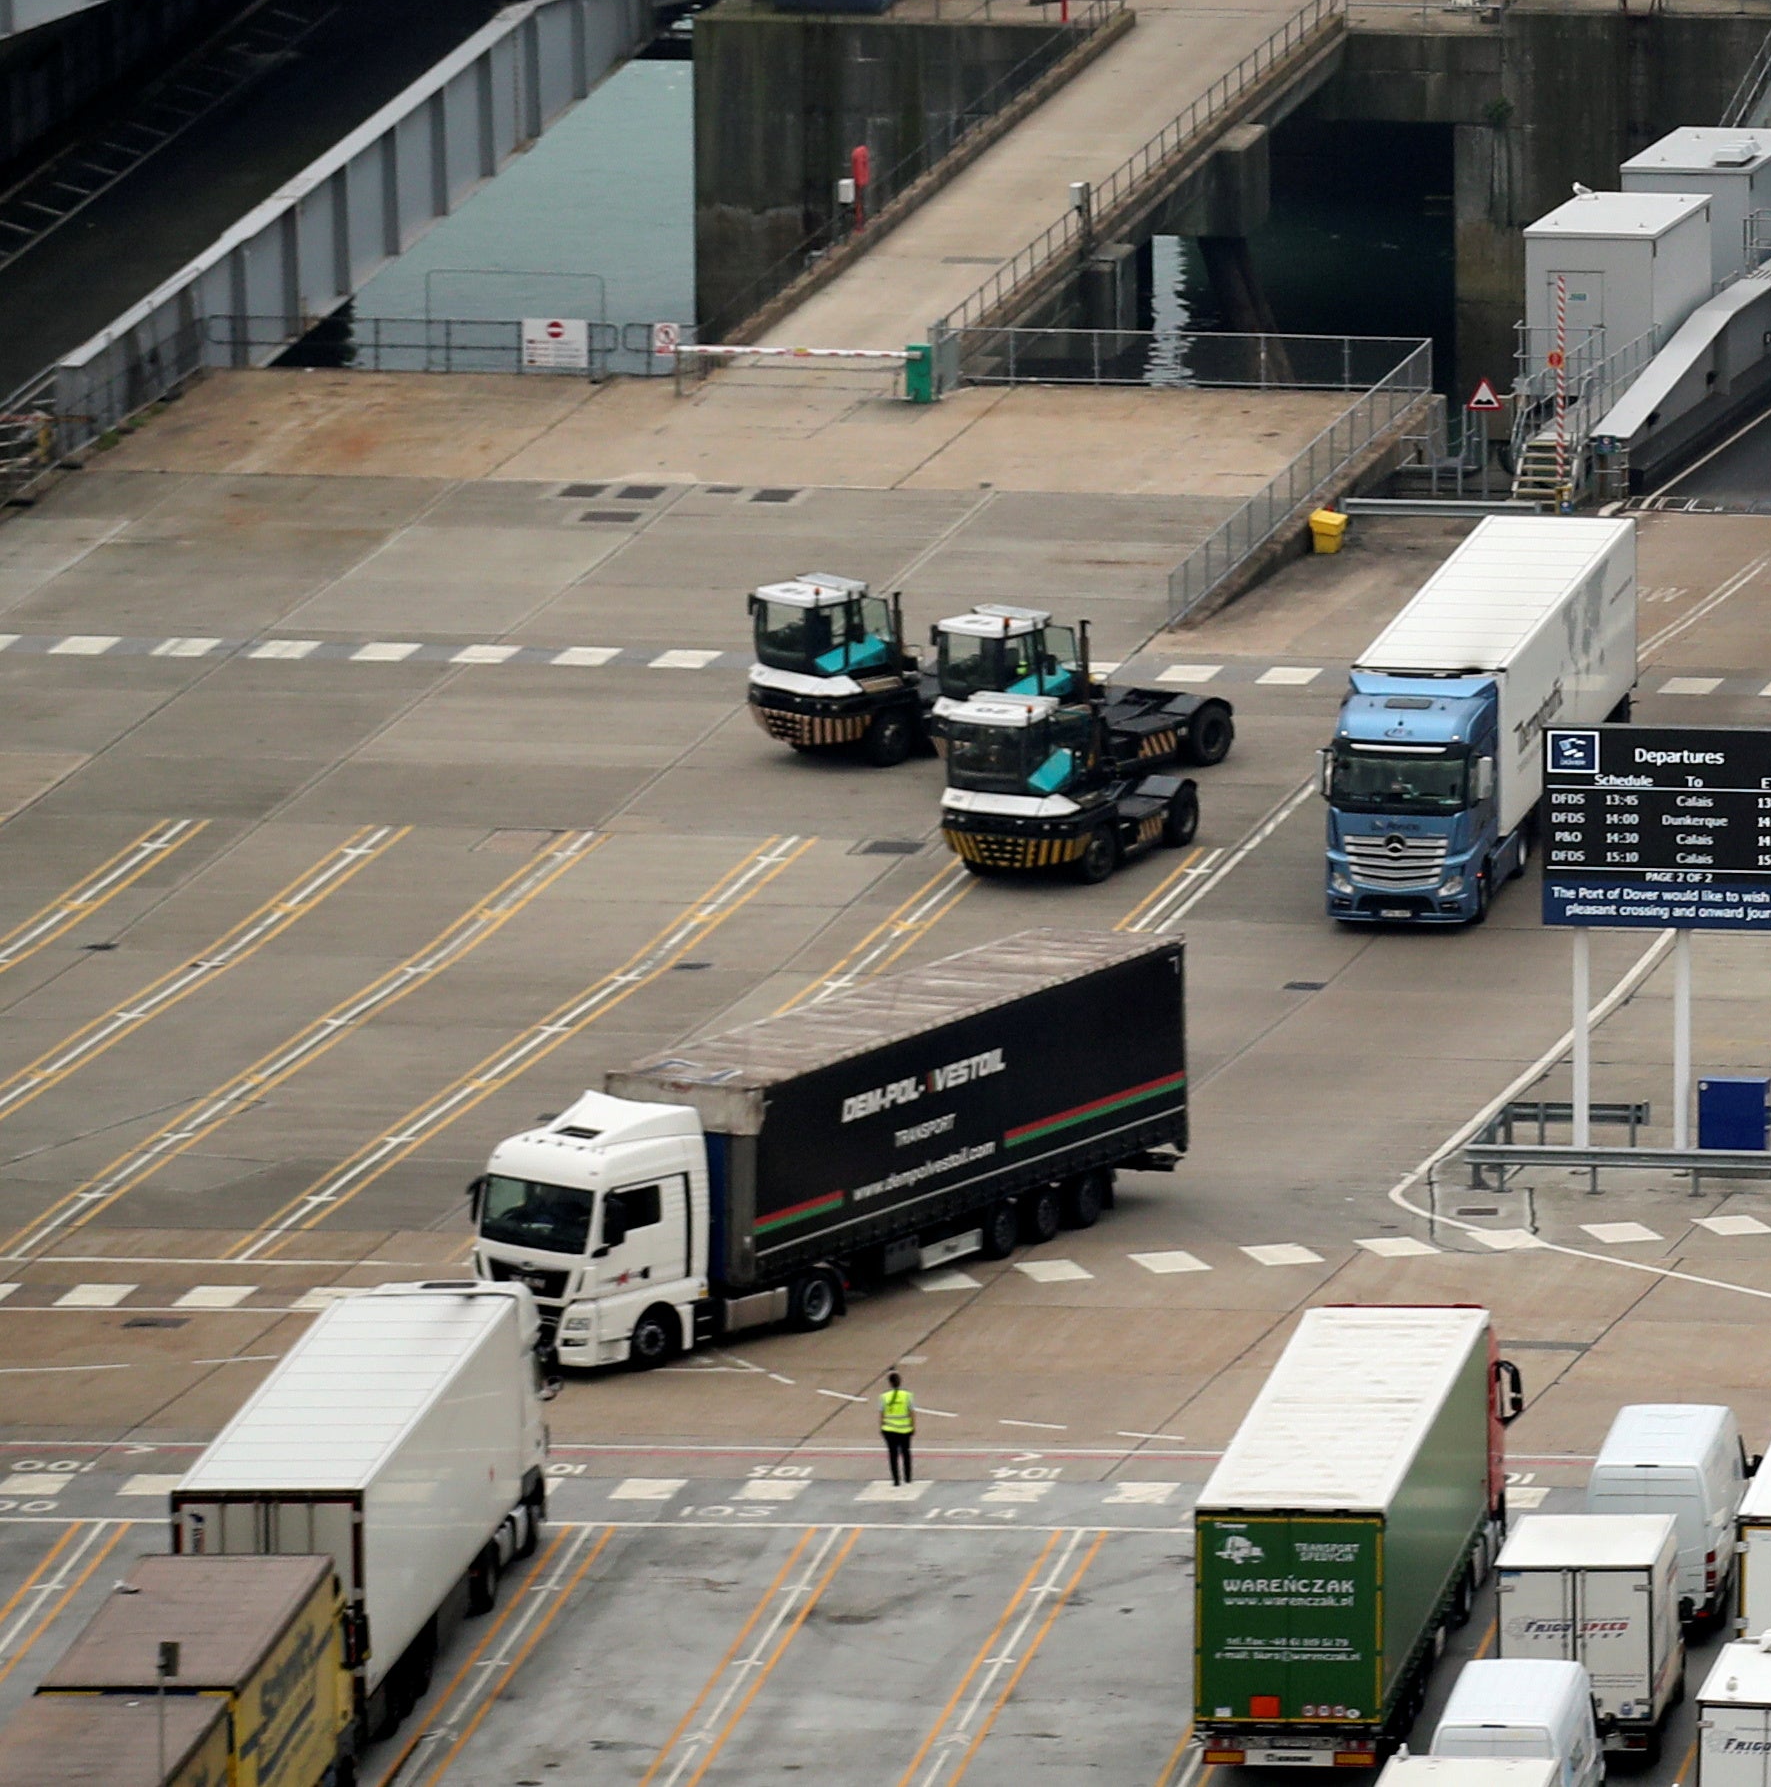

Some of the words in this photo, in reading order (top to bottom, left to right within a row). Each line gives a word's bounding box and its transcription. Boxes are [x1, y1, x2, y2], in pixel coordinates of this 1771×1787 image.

[1634, 748, 1725, 765] Departures
[1594, 774, 1654, 787] Schedule
[1685, 776, 1704, 788] To
[1551, 794, 1585, 805] DFDS
[1605, 795, 1639, 806] 13:45
[1676, 796, 1713, 808] Calais
[1551, 813, 1585, 824] DFDS
[1605, 814, 1639, 825] 14:00
[1662, 815, 1728, 828] Dunkerque
[1555, 832, 1582, 843] P&O
[1605, 833, 1640, 844] 14:30
[1676, 834, 1713, 846] Calais
[1551, 851, 1585, 862] DFDS
[1606, 851, 1640, 863] 15:10
[1676, 853, 1713, 865] Calais
[1645, 872, 1674, 882] PAGE
[1676, 873, 1684, 883] 2
[1686, 873, 1703, 883] OF
[1705, 873, 1713, 883] 2
[1552, 886, 1575, 899] The
[1578, 887, 1604, 900] Port
[1607, 887, 1621, 900] of
[1623, 888, 1659, 901] Dover
[1661, 889, 1699, 902] would
[1701, 890, 1723, 902] like
[1725, 892, 1739, 903] to
[1742, 891, 1770, 904] wish
[1565, 904, 1617, 917] pleasant
[1619, 905, 1670, 919] crossing
[1672, 905, 1696, 918] and
[1698, 907, 1744, 919] onward
[894, 1113, 957, 1148] TRANSPORT
[1294, 1543, 1360, 1553] TRANSPORT
[1223, 1575, 1355, 1593] WAREŃCZAK
[1223, 1596, 1354, 1608] www.warenczak.pl
[1580, 1622, 1629, 1632] SPEED
